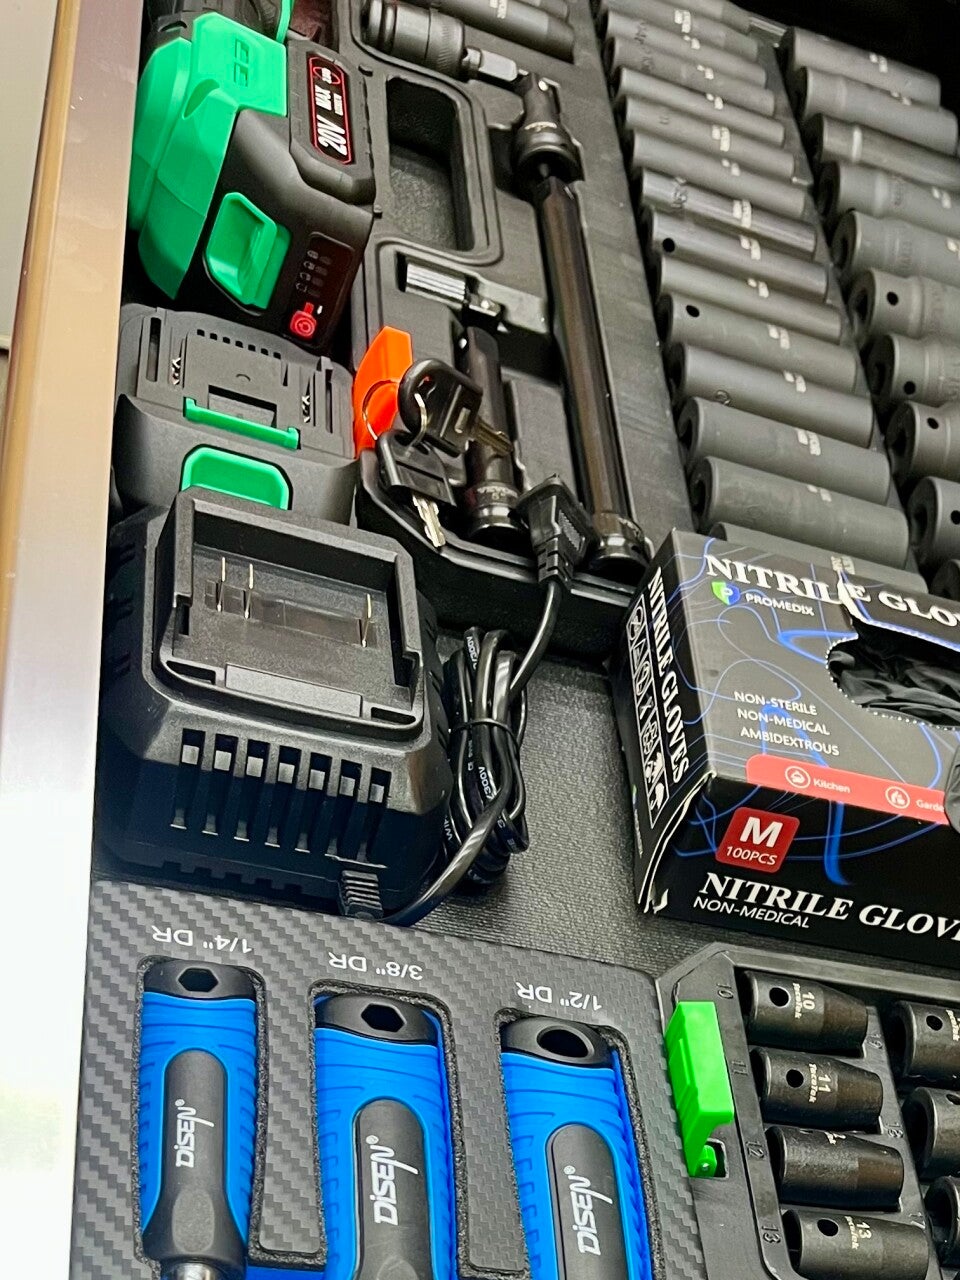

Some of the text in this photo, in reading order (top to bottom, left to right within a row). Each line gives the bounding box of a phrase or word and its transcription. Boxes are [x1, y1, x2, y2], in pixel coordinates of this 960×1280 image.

[316, 114, 348, 156] 20V
[704, 554, 870, 606] NITRILE
[745, 593, 815, 617] PROMEDIX
[647, 566, 691, 785] NITRILE GLOVES
[733, 691, 818, 716] NON-STERILE
[736, 708, 831, 737] NON-MEDICAL
[740, 726, 840, 757] AMBIDEXTROUS
[813, 777, 851, 794] Kitchen
[738, 816, 784, 848] M
[725, 844, 778, 867] 100PCS
[698, 871, 854, 921] NITRILE
[693, 896, 810, 929] NON-MEDICAL
[151, 924, 253, 955] 1/4" DR
[328, 951, 424, 982] 3/8" DR
[516, 981, 603, 1012] 1/2" DR
[803, 990, 816, 1011] 10
[817, 1073, 831, 1094] 11
[858, 1220, 872, 1240] 13
